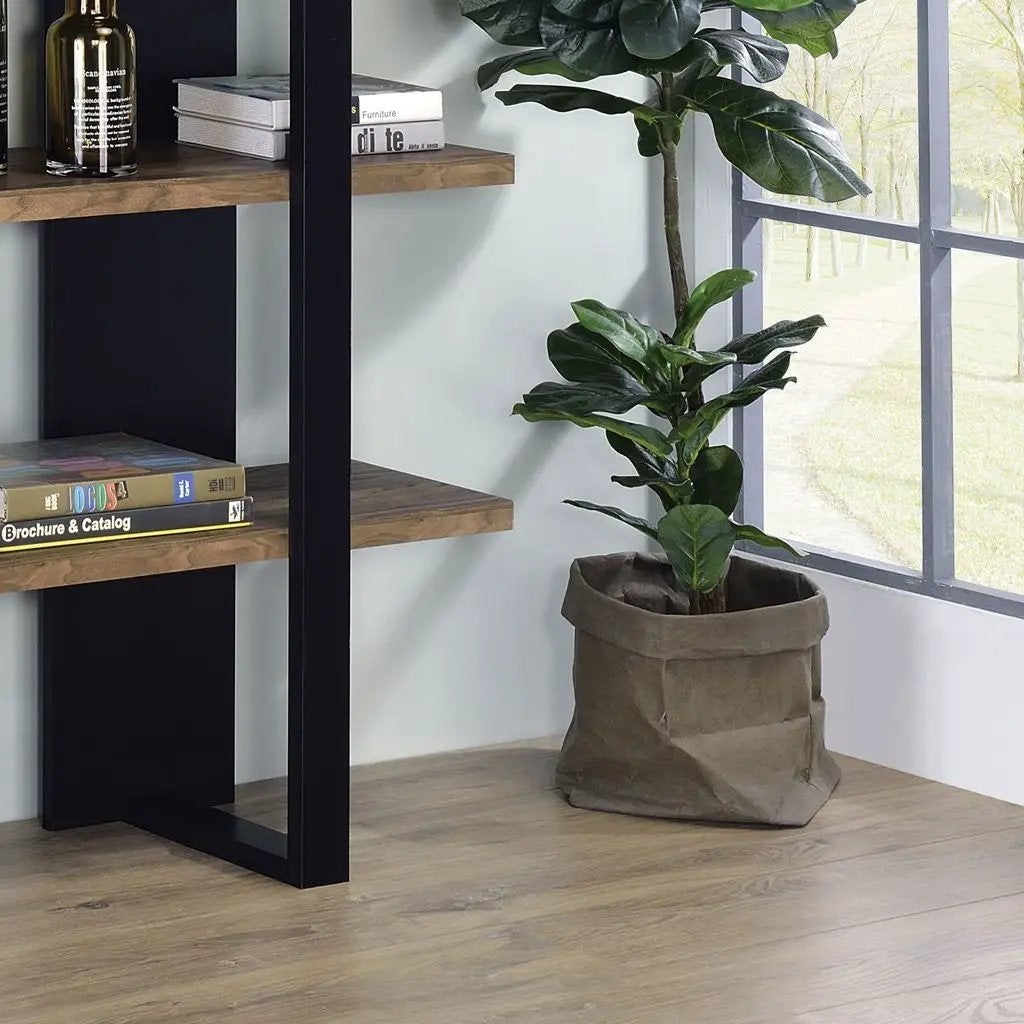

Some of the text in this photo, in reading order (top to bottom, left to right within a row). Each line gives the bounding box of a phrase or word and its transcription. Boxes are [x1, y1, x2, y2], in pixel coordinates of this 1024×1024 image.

[362, 109, 397, 119] Furniture
[357, 127, 375, 154] di
[385, 127, 404, 152] te
[1, 516, 131, 542] Brochure & Catalog
